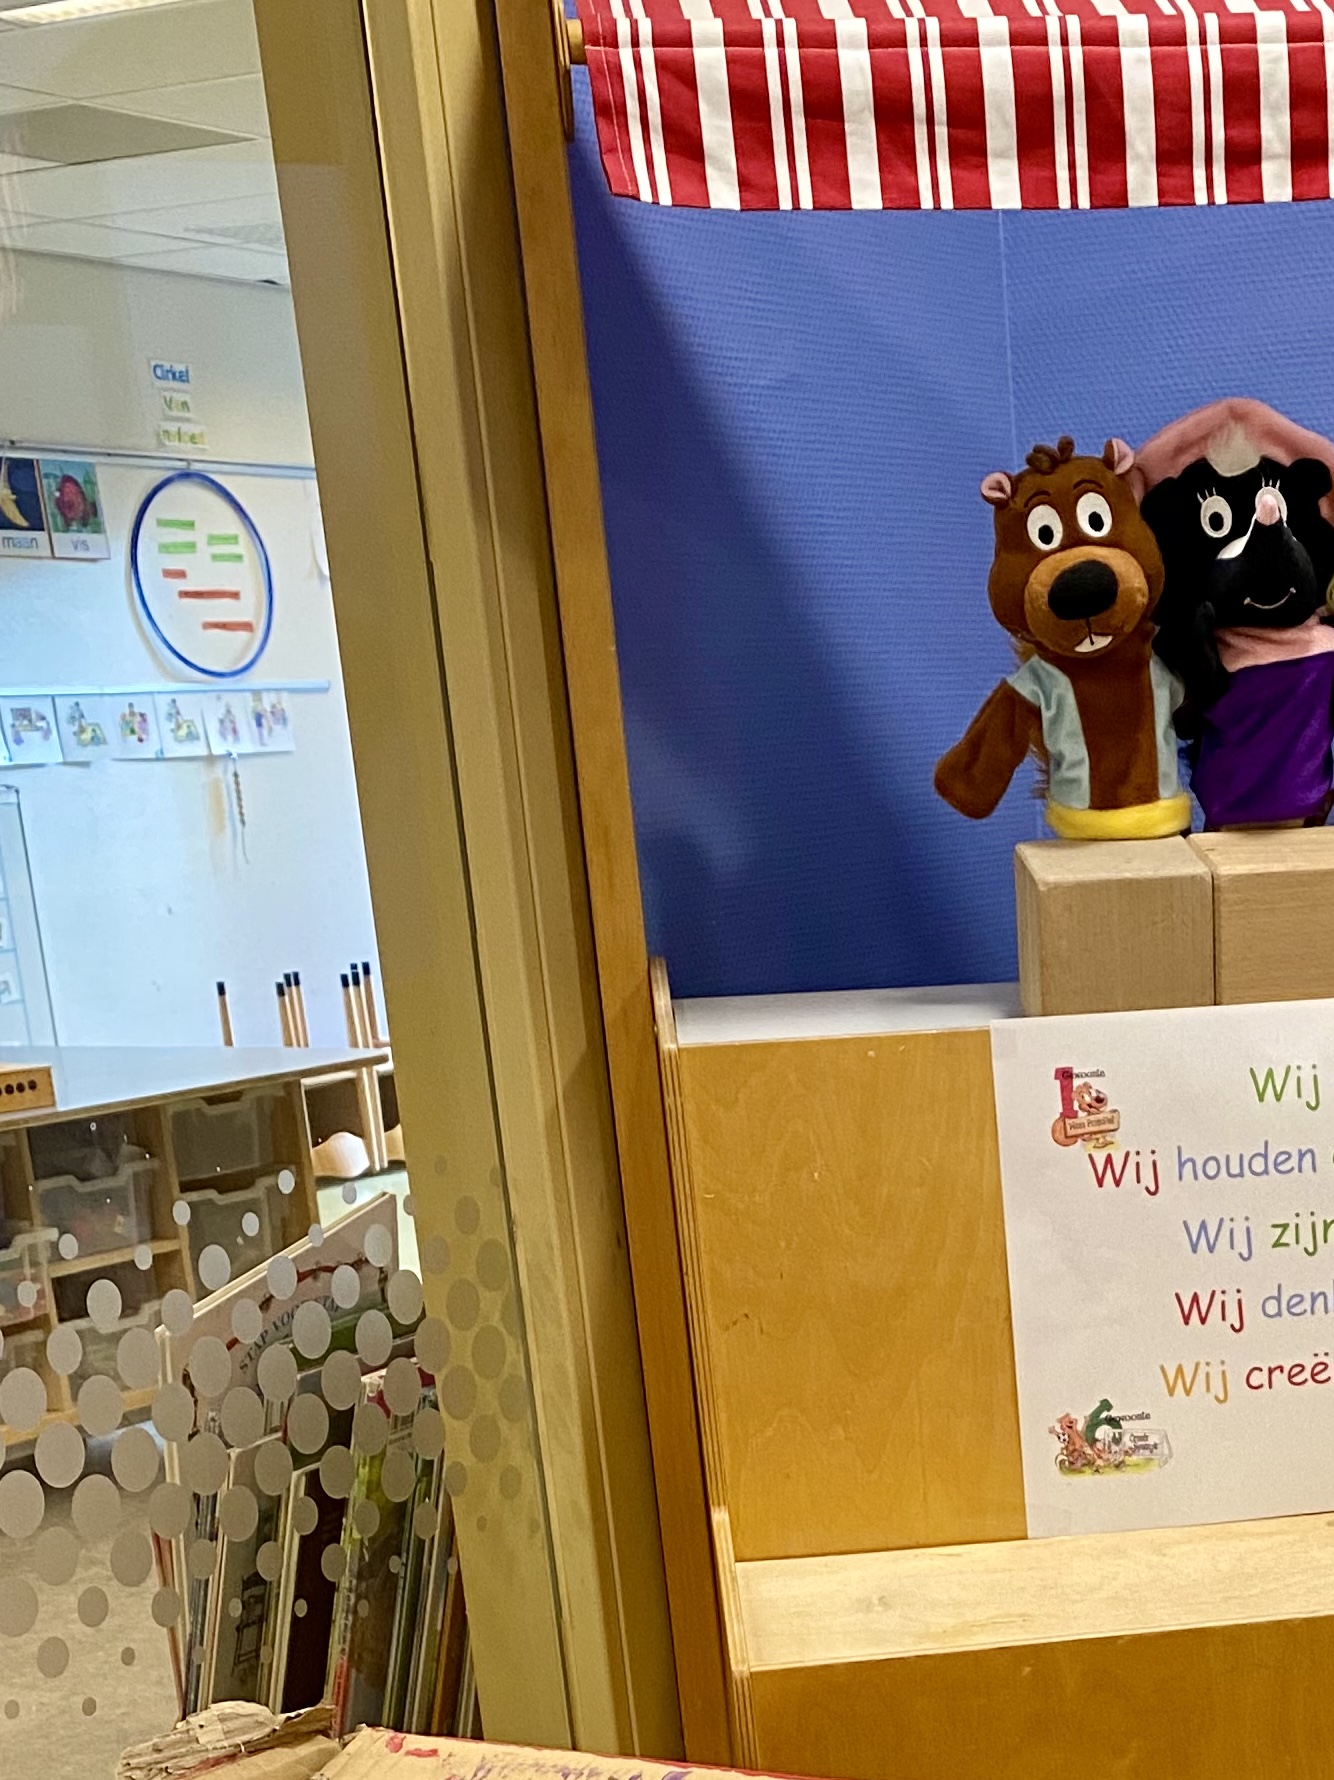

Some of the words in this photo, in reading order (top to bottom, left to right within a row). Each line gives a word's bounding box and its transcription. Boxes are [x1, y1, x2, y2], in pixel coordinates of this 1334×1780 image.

[153, 363, 191, 384] Cirkel
[2, 536, 39, 549] maan
[1249, 1063, 1321, 1111] Wij
[1089, 1149, 1160, 1196] Wij
[1177, 1140, 1317, 1181] houden
[1183, 1216, 1253, 1262] Wij
[1175, 1287, 1244, 1333] Wij
[1159, 1359, 1229, 1404] Wij
